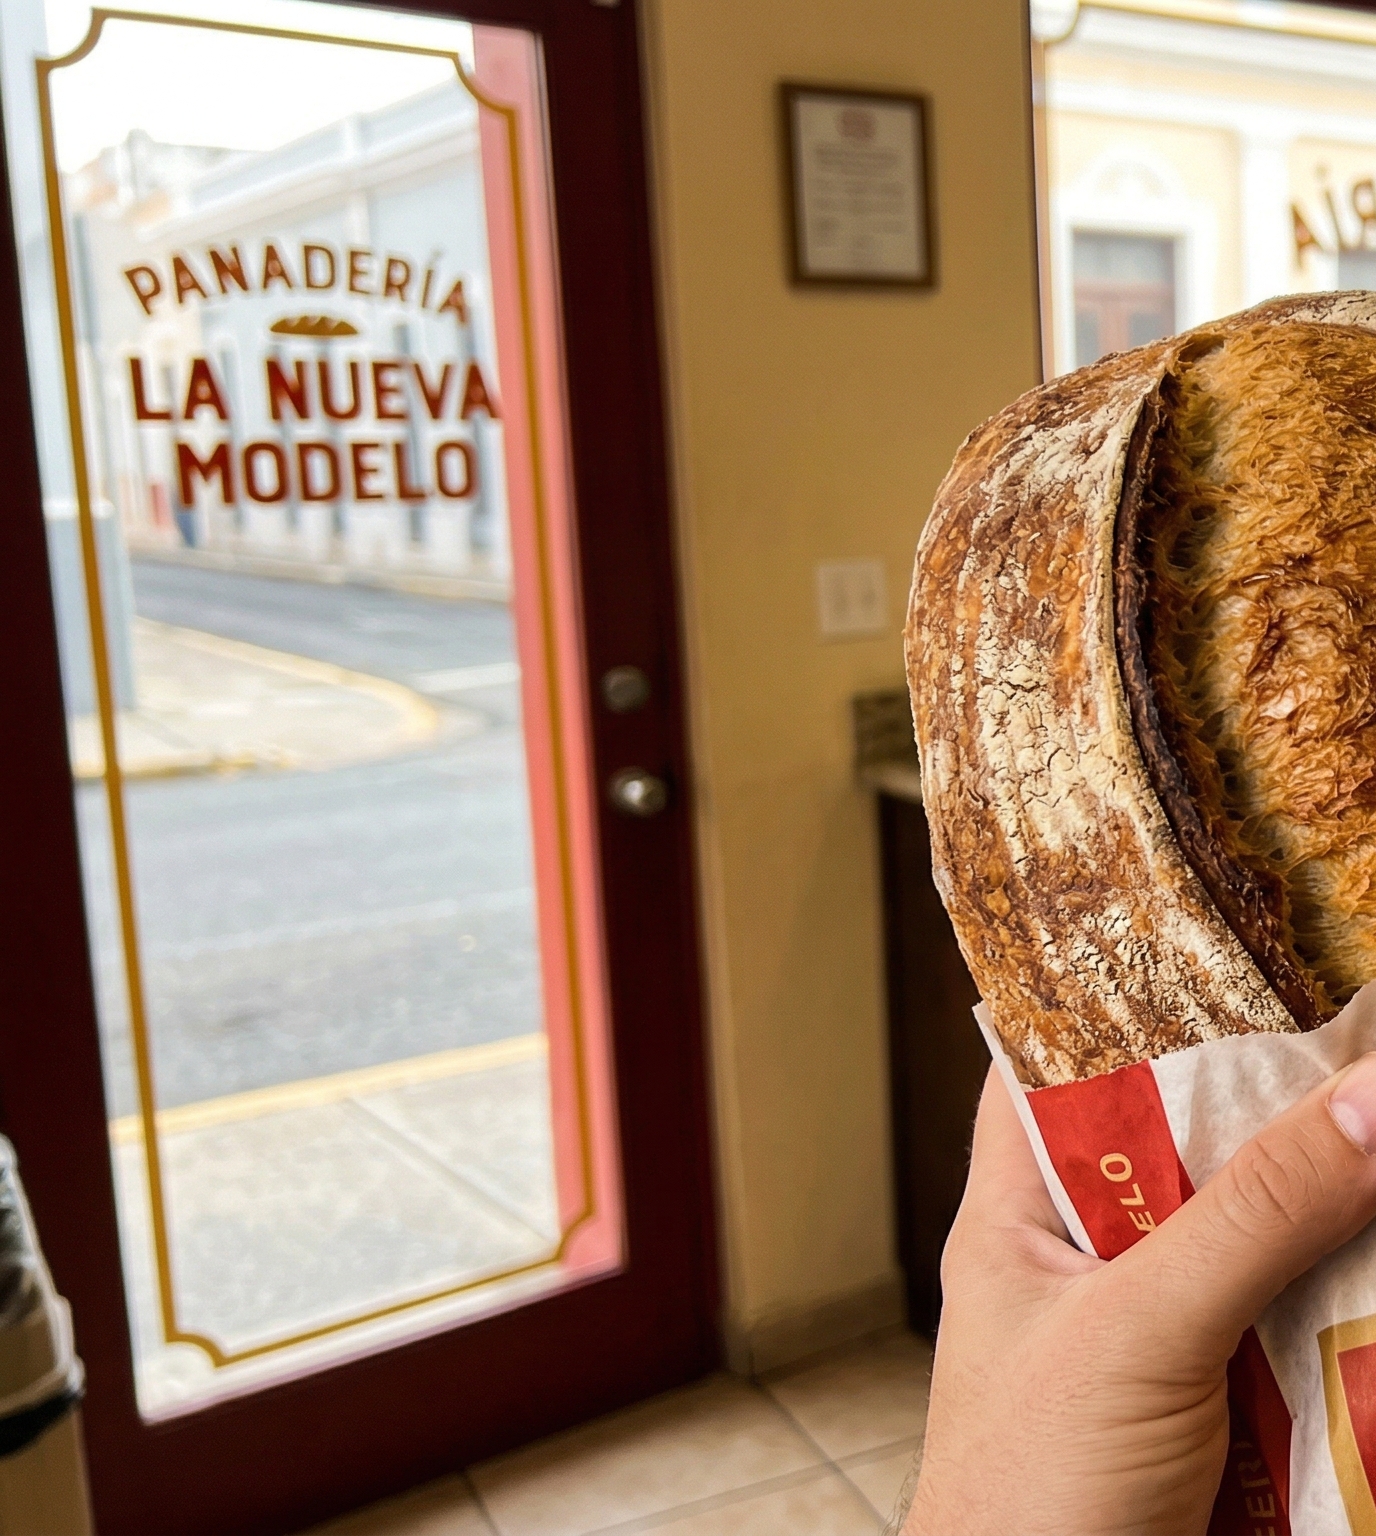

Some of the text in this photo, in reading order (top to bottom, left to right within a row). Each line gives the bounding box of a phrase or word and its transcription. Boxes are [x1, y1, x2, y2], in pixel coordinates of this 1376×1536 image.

[124, 244, 469, 324] PANADERÍA
[128, 356, 501, 421] LA NUEVA
[176, 441, 476, 505] MODELO
[1099, 1152, 1157, 1233] ELO
